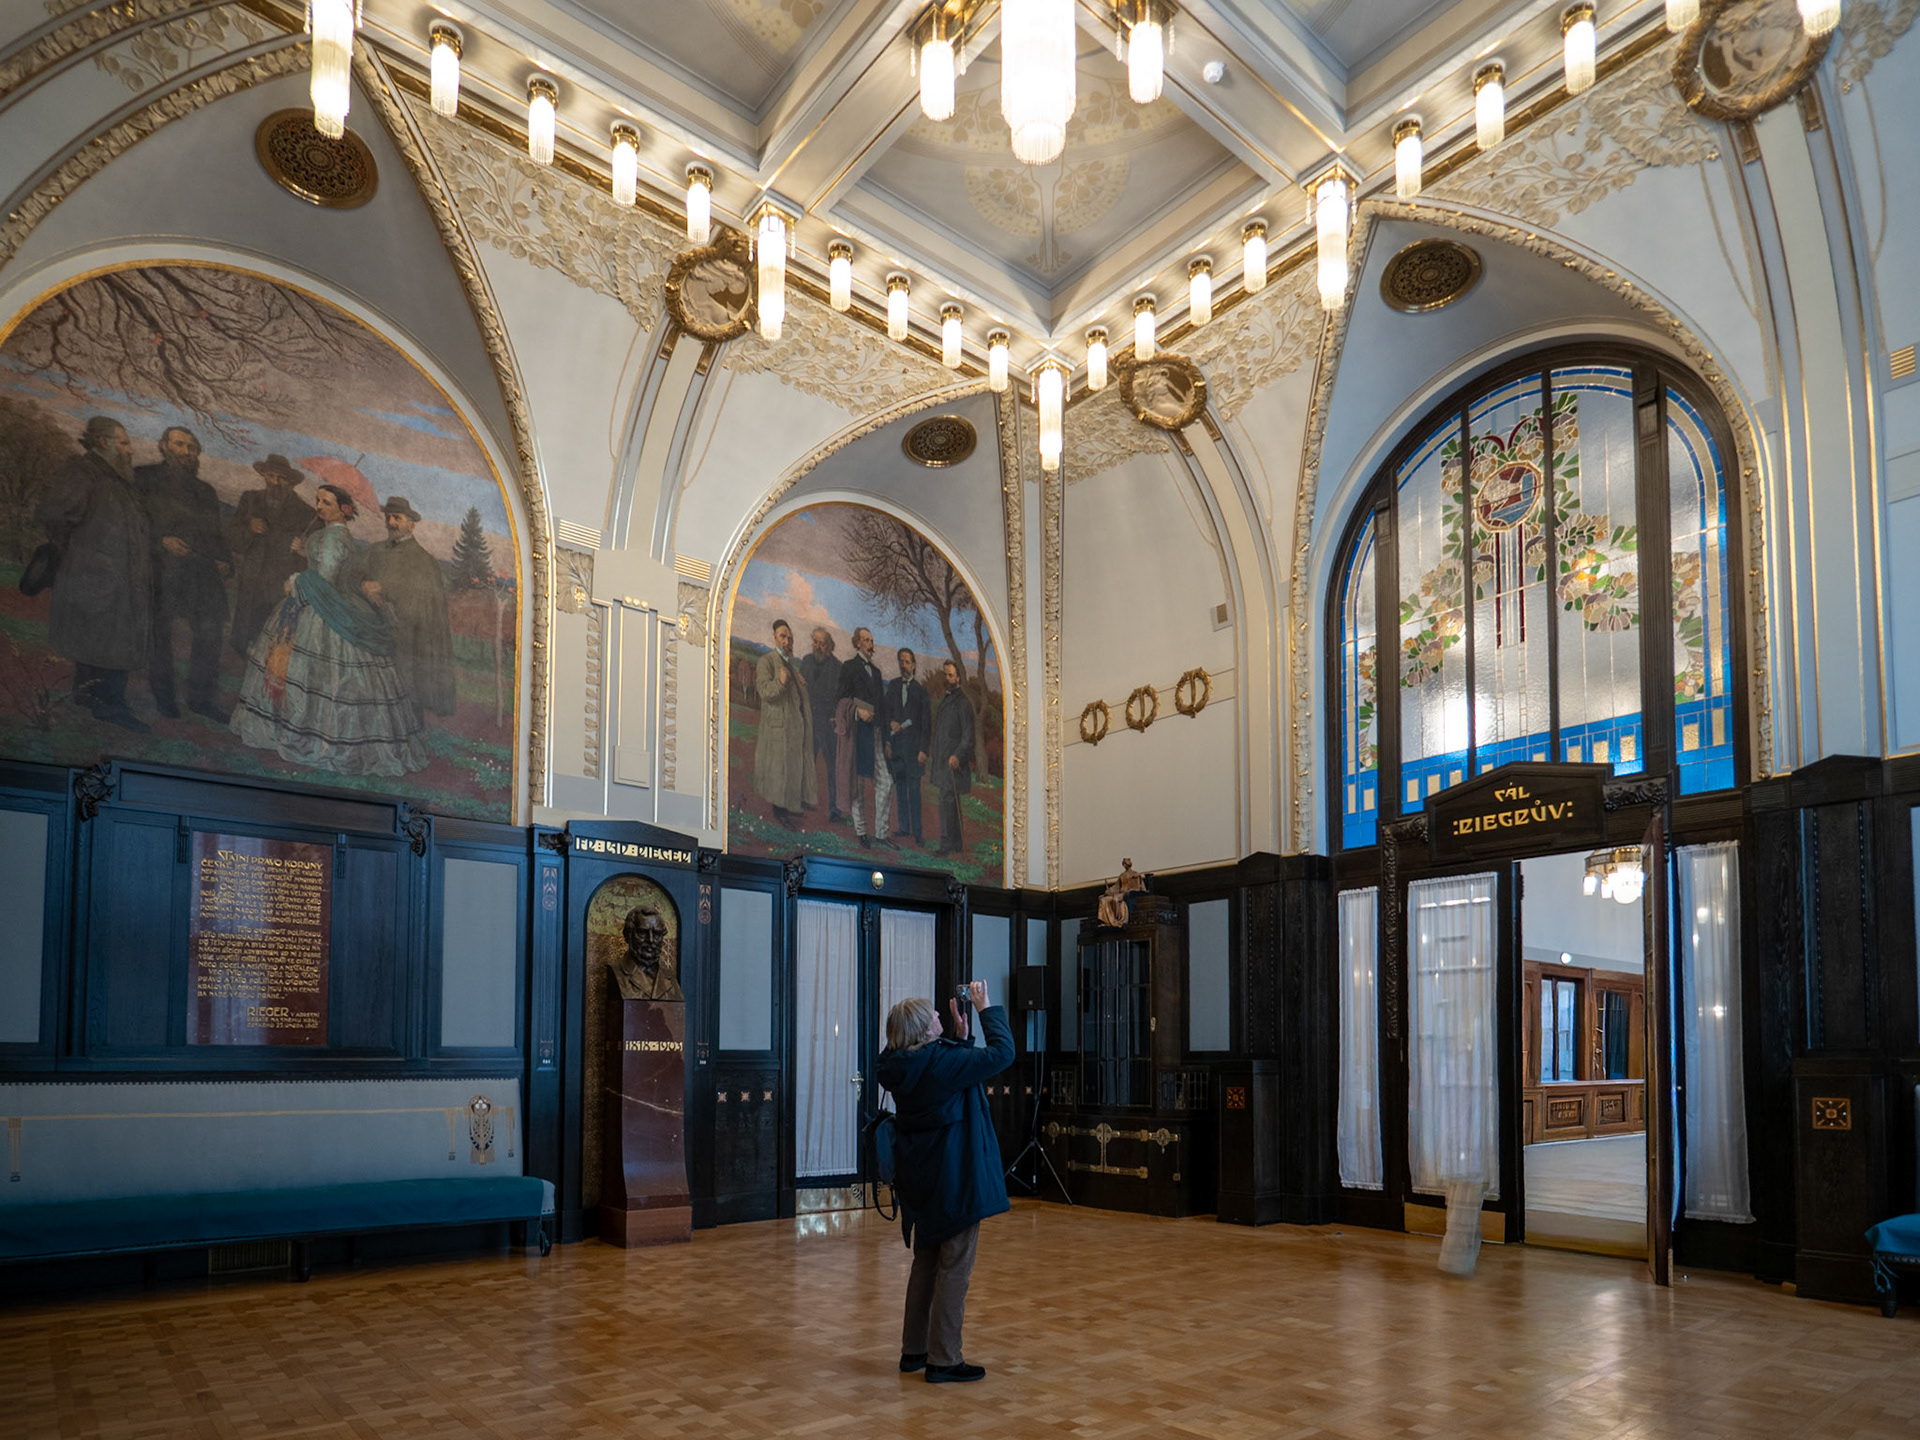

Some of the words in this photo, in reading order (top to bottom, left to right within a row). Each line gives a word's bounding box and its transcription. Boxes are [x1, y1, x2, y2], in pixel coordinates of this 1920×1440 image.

[1494, 782, 1530, 802] SÁL
[285, 859, 322, 870] KORUNY
[247, 1006, 288, 1016] RIEGER
